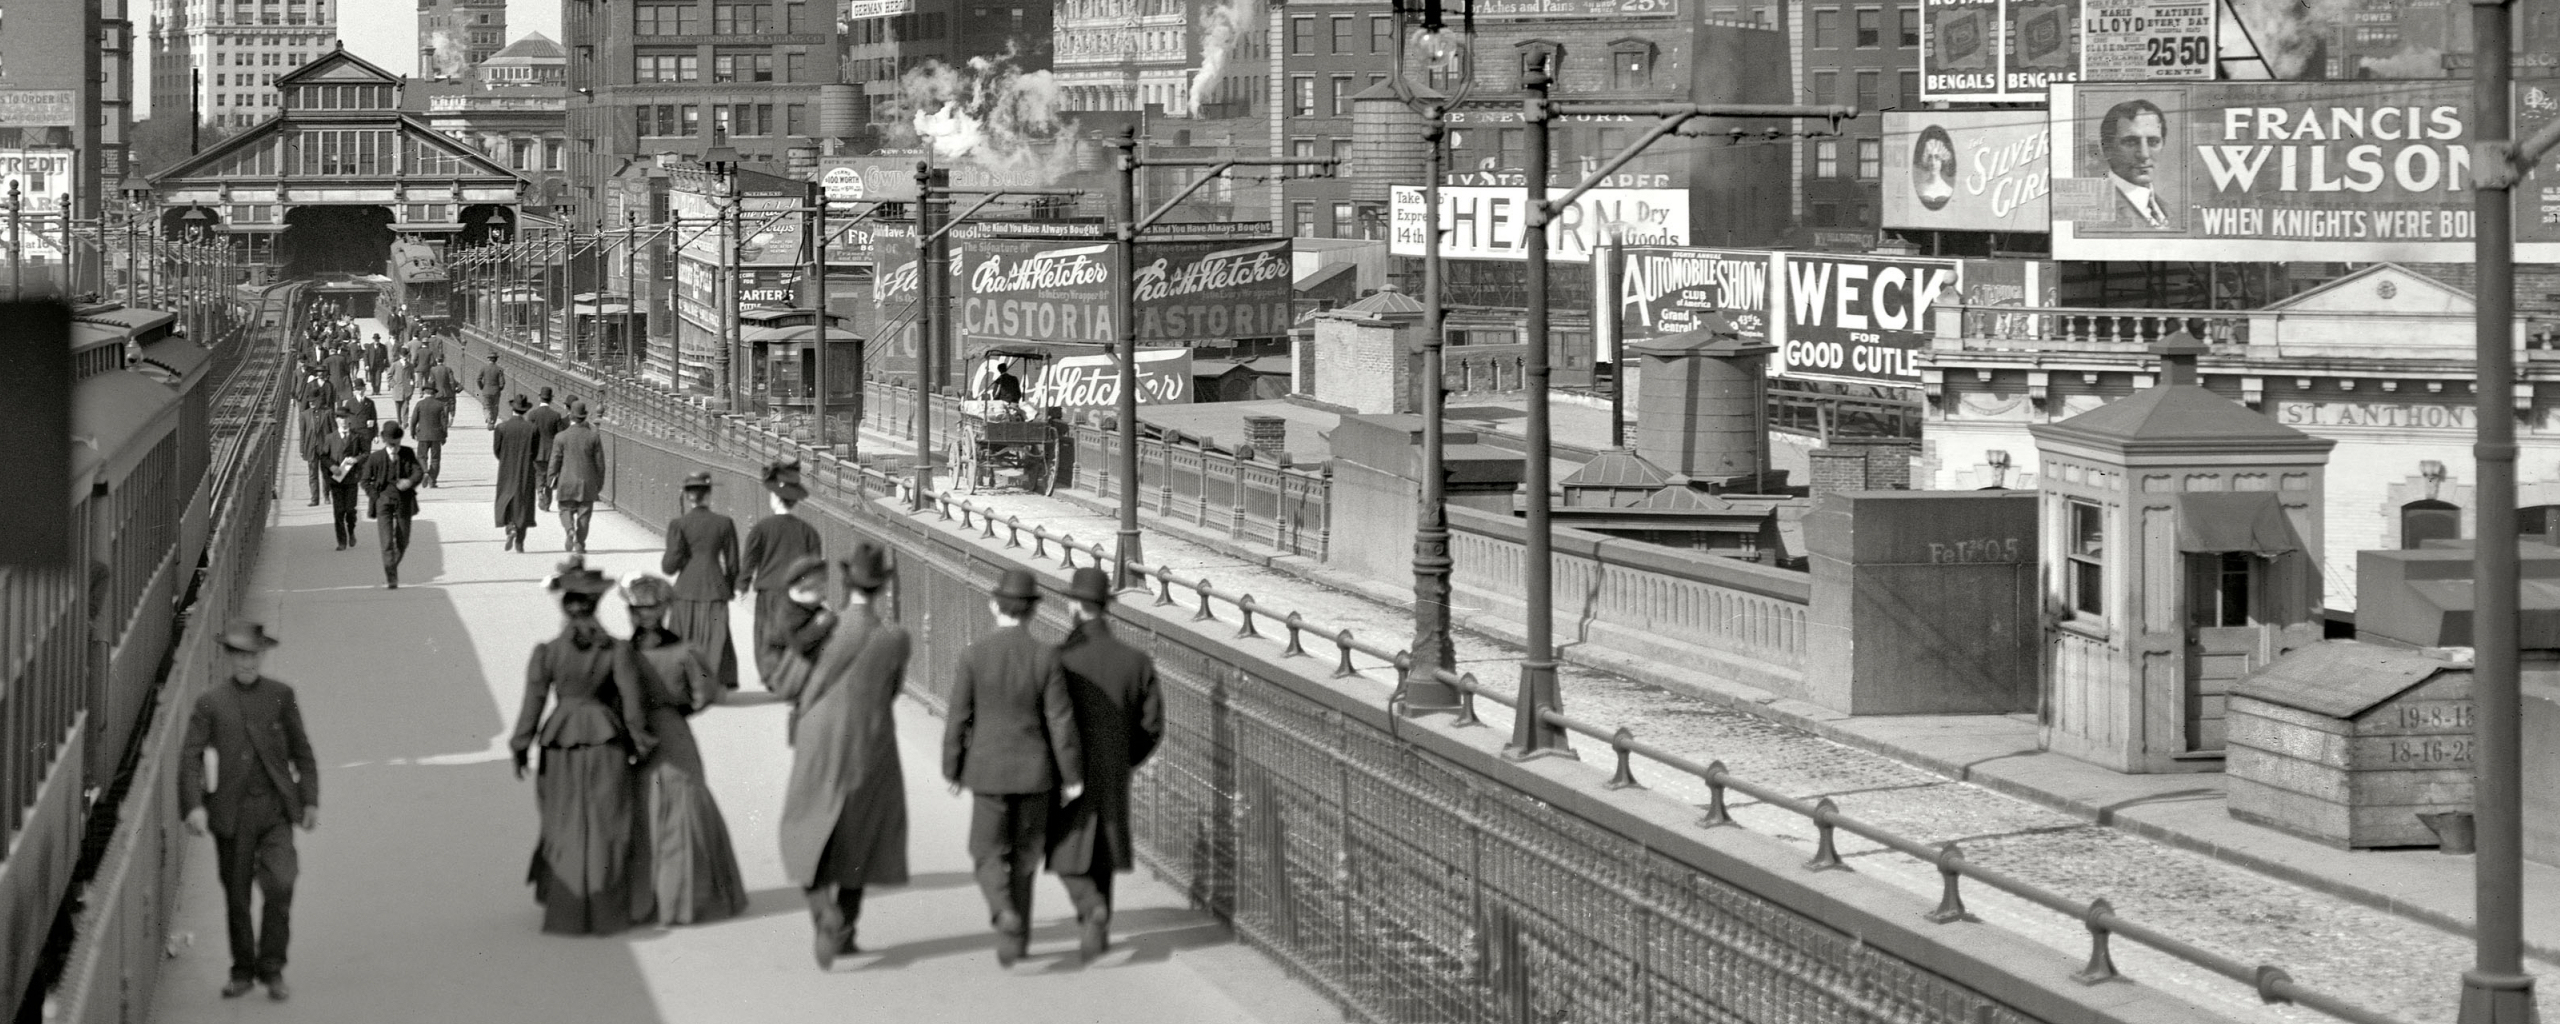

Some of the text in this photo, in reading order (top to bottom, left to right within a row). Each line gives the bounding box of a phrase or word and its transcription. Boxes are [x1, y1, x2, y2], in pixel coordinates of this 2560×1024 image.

[855, 2, 882, 16] GERMAN
[1482, 0, 1517, 13] Aches
[1519, 1, 1539, 12] and
[1544, 0, 1574, 12] Pains
[2100, 8, 2203, 17] MARIE MATINEE
[2088, 17, 2144, 33] LLOYD
[2147, 17, 2210, 27] EVERY DAY
[2355, 13, 2392, 22] POWER
[2147, 37, 2176, 66] 25
[2180, 36, 2210, 65] 50
[1928, 74, 1995, 90] BENGALS
[2224, 106, 2463, 140] FRANCIS
[1396, 191, 1421, 205] Take
[1397, 209, 1441, 223] Expres
[978, 222, 991, 232] The
[992, 223, 1008, 233] Kind
[1009, 224, 1022, 233] You
[1023, 225, 1040, 233] Have
[1041, 225, 1068, 236] Always
[1153, 225, 1171, 233] Kind
[1172, 225, 1185, 233] You
[1187, 225, 1206, 233] Have
[1207, 224, 1236, 234] Always
[1452, 195, 1670, 255] HERN Dry
[2272, 210, 2367, 238] KNIGHTS
[2373, 211, 2433, 238] WERE
[1626, 227, 1680, 247] Goods
[964, 242, 977, 253] The
[979, 241, 1019, 258] Signature
[1622, 254, 1768, 326] AUTOMOBILE SHOW
[1682, 290, 1707, 300] CLUB
[1788, 261, 1947, 334] WECK
[964, 297, 1113, 342] CASTORIA
[1134, 302, 1290, 338] ASTORIA
[1661, 308, 1690, 321] Grand
[1658, 320, 1692, 333] Central
[1850, 333, 1880, 344] FOR
[1786, 340, 1844, 369] GOOD
